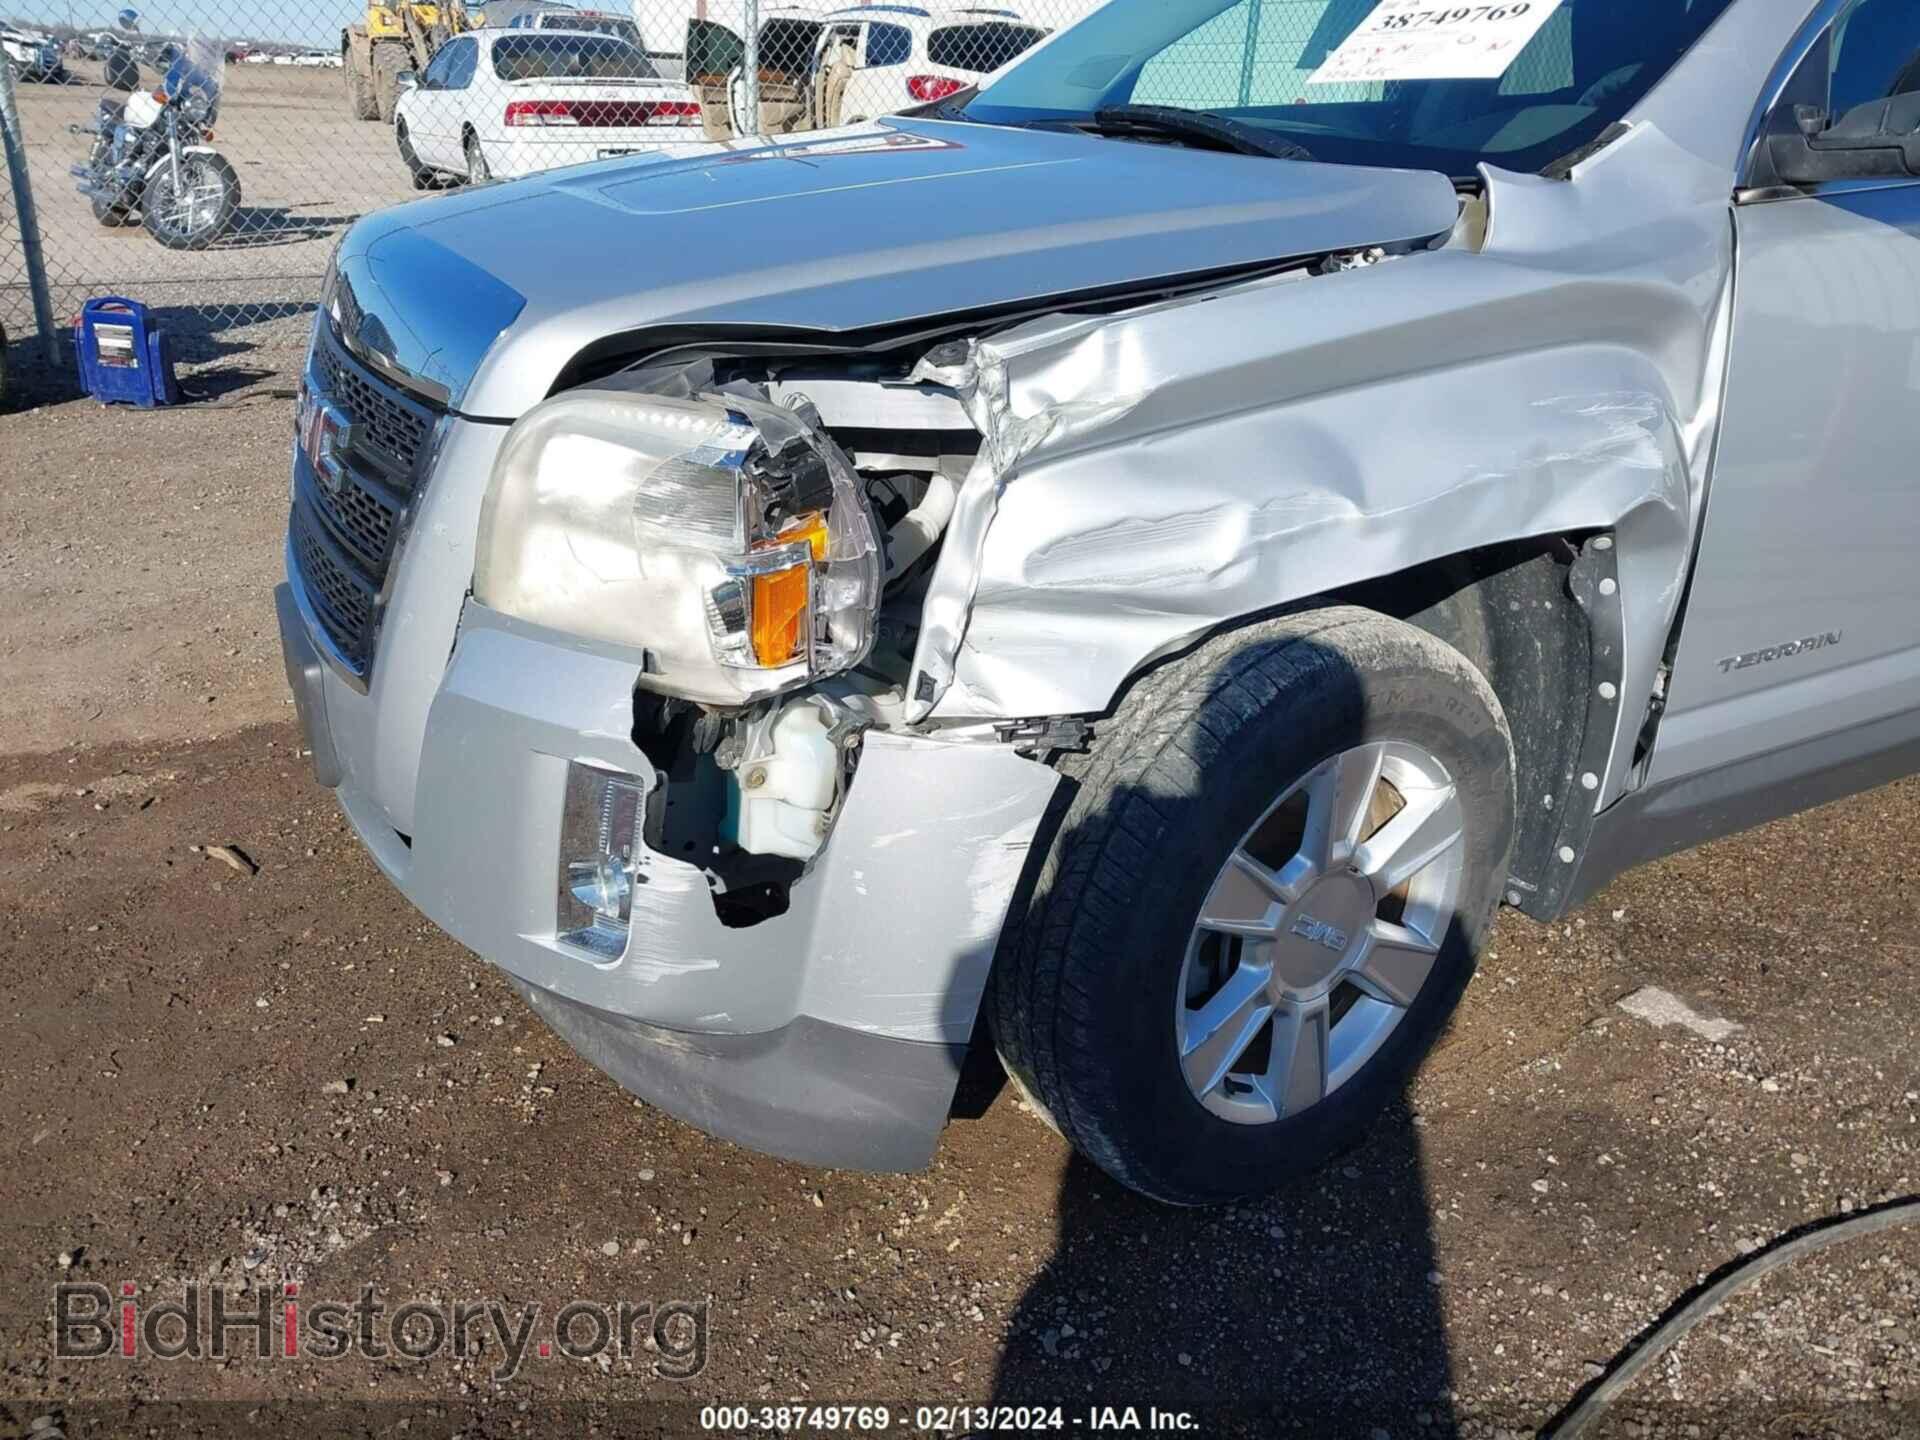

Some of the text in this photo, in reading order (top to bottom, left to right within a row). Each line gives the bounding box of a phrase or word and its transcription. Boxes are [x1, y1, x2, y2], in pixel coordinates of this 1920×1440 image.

[1377, 2, 1531, 31] 38749769
[1716, 629, 1843, 674] TERRAIN
[1290, 913, 1348, 952] GMC
